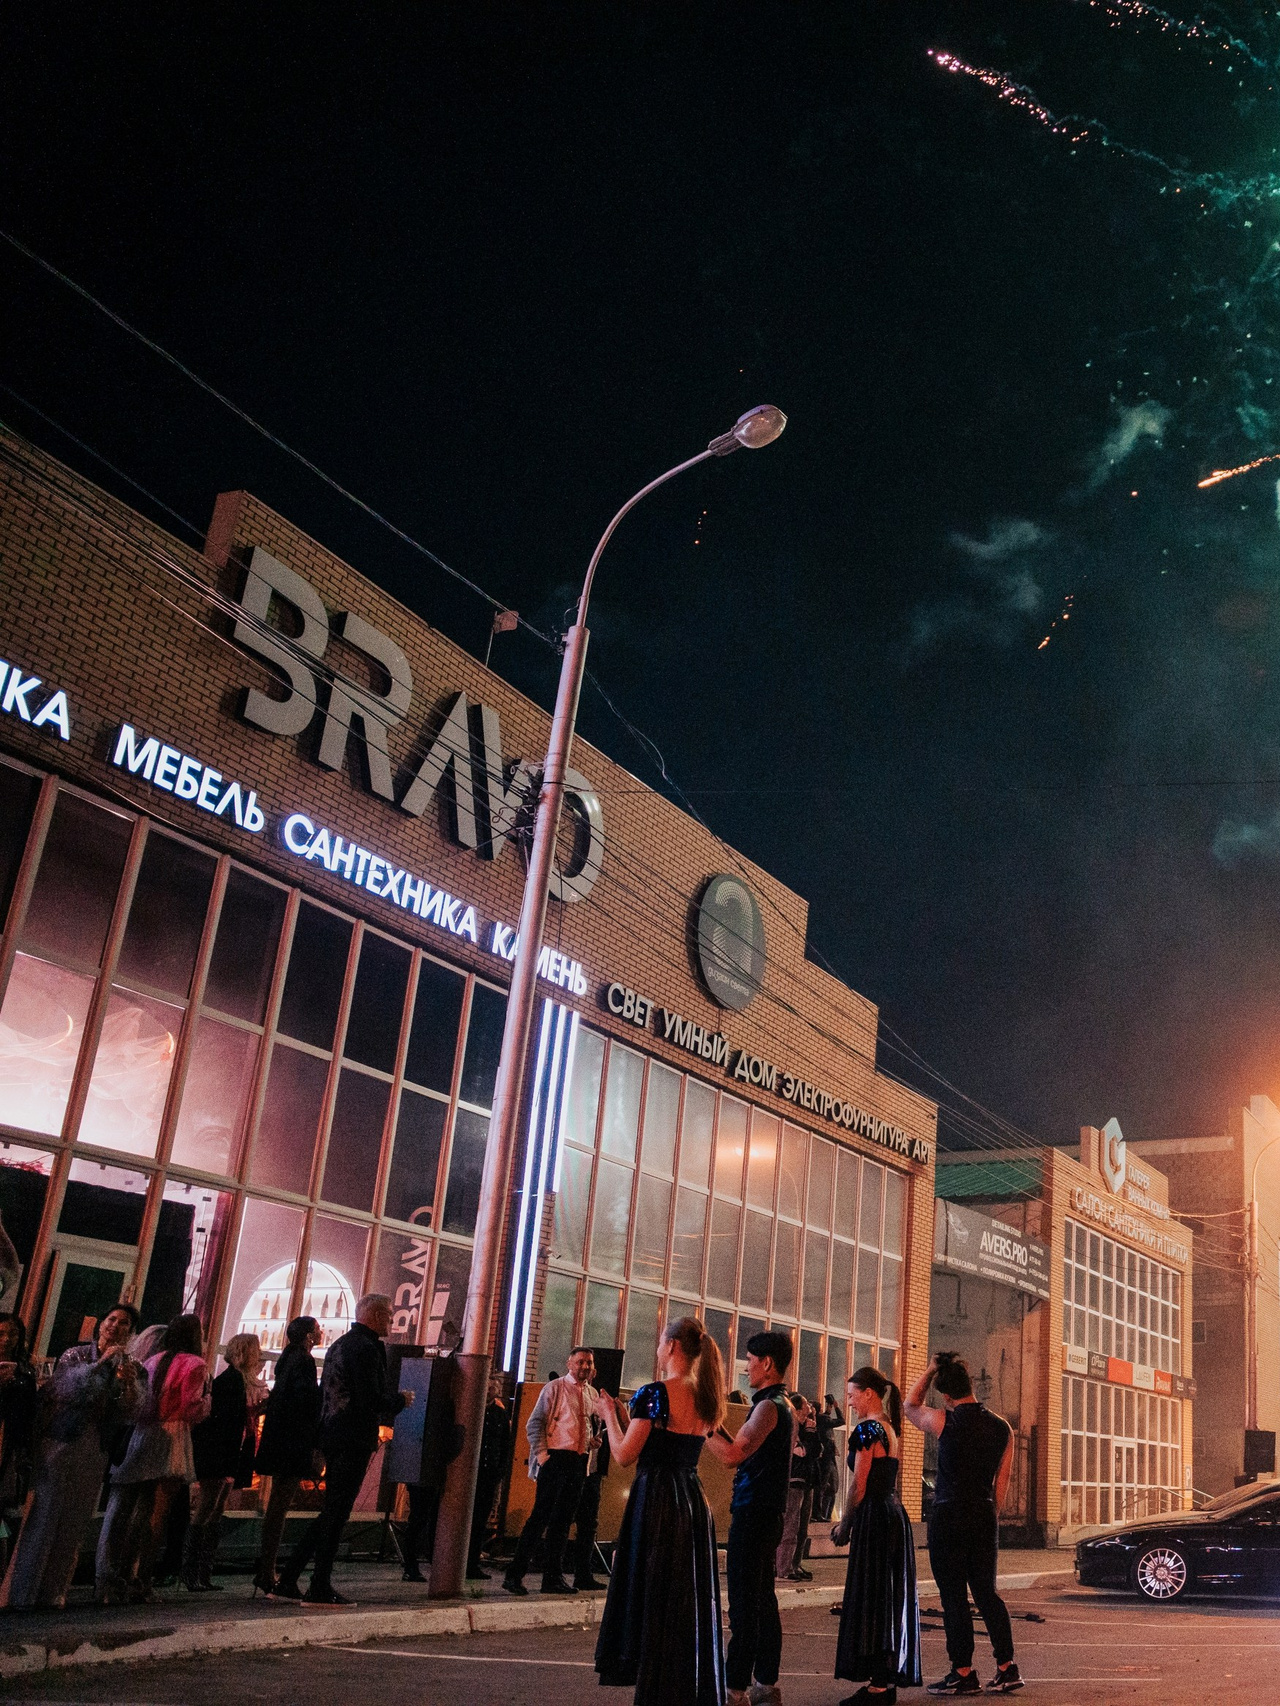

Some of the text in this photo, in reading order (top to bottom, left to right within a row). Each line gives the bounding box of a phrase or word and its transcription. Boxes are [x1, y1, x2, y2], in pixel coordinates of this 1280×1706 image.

[234, 546, 604, 903] BRAVO
[113, 723, 265, 833] МЕБЕЛЬ
[283, 813, 478, 943] САНТЕХНИКА
[607, 982, 655, 1029] СВЕТ
[663, 1007, 730, 1068] УМНЫЙ
[734, 1049, 777, 1092] ДОМ
[782, 1072, 909, 1156] ЭЛЕКТРОФУРНИТУРА
[980, 1230, 1028, 1267] AVERS.PRO
